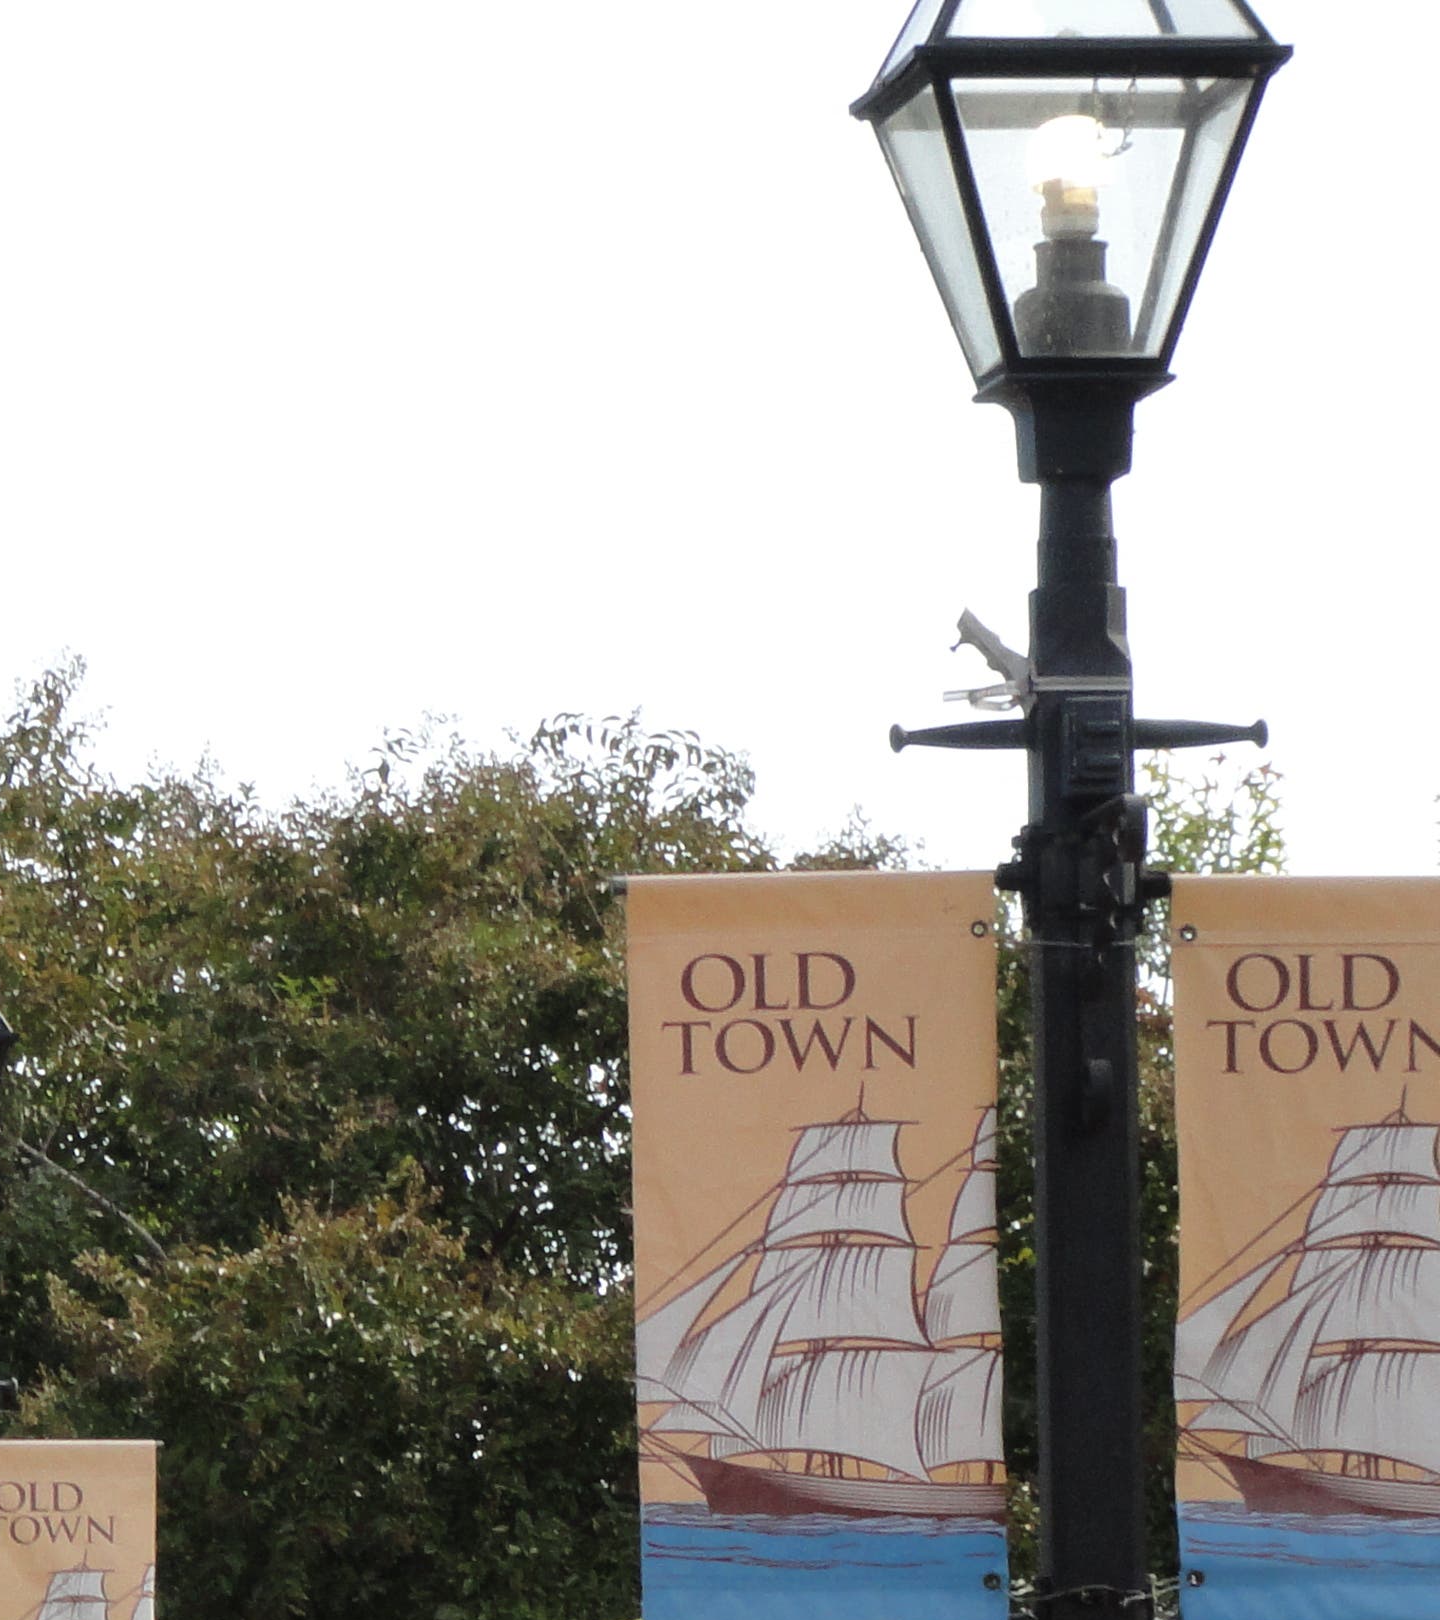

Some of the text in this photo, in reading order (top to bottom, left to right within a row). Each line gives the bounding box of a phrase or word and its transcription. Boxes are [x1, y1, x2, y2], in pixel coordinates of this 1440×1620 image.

[680, 952, 856, 1012] OLD
[1226, 953, 1400, 1012] OLD
[661, 1015, 919, 1075] TOWN
[1205, 1018, 1440, 1075] TOWN
